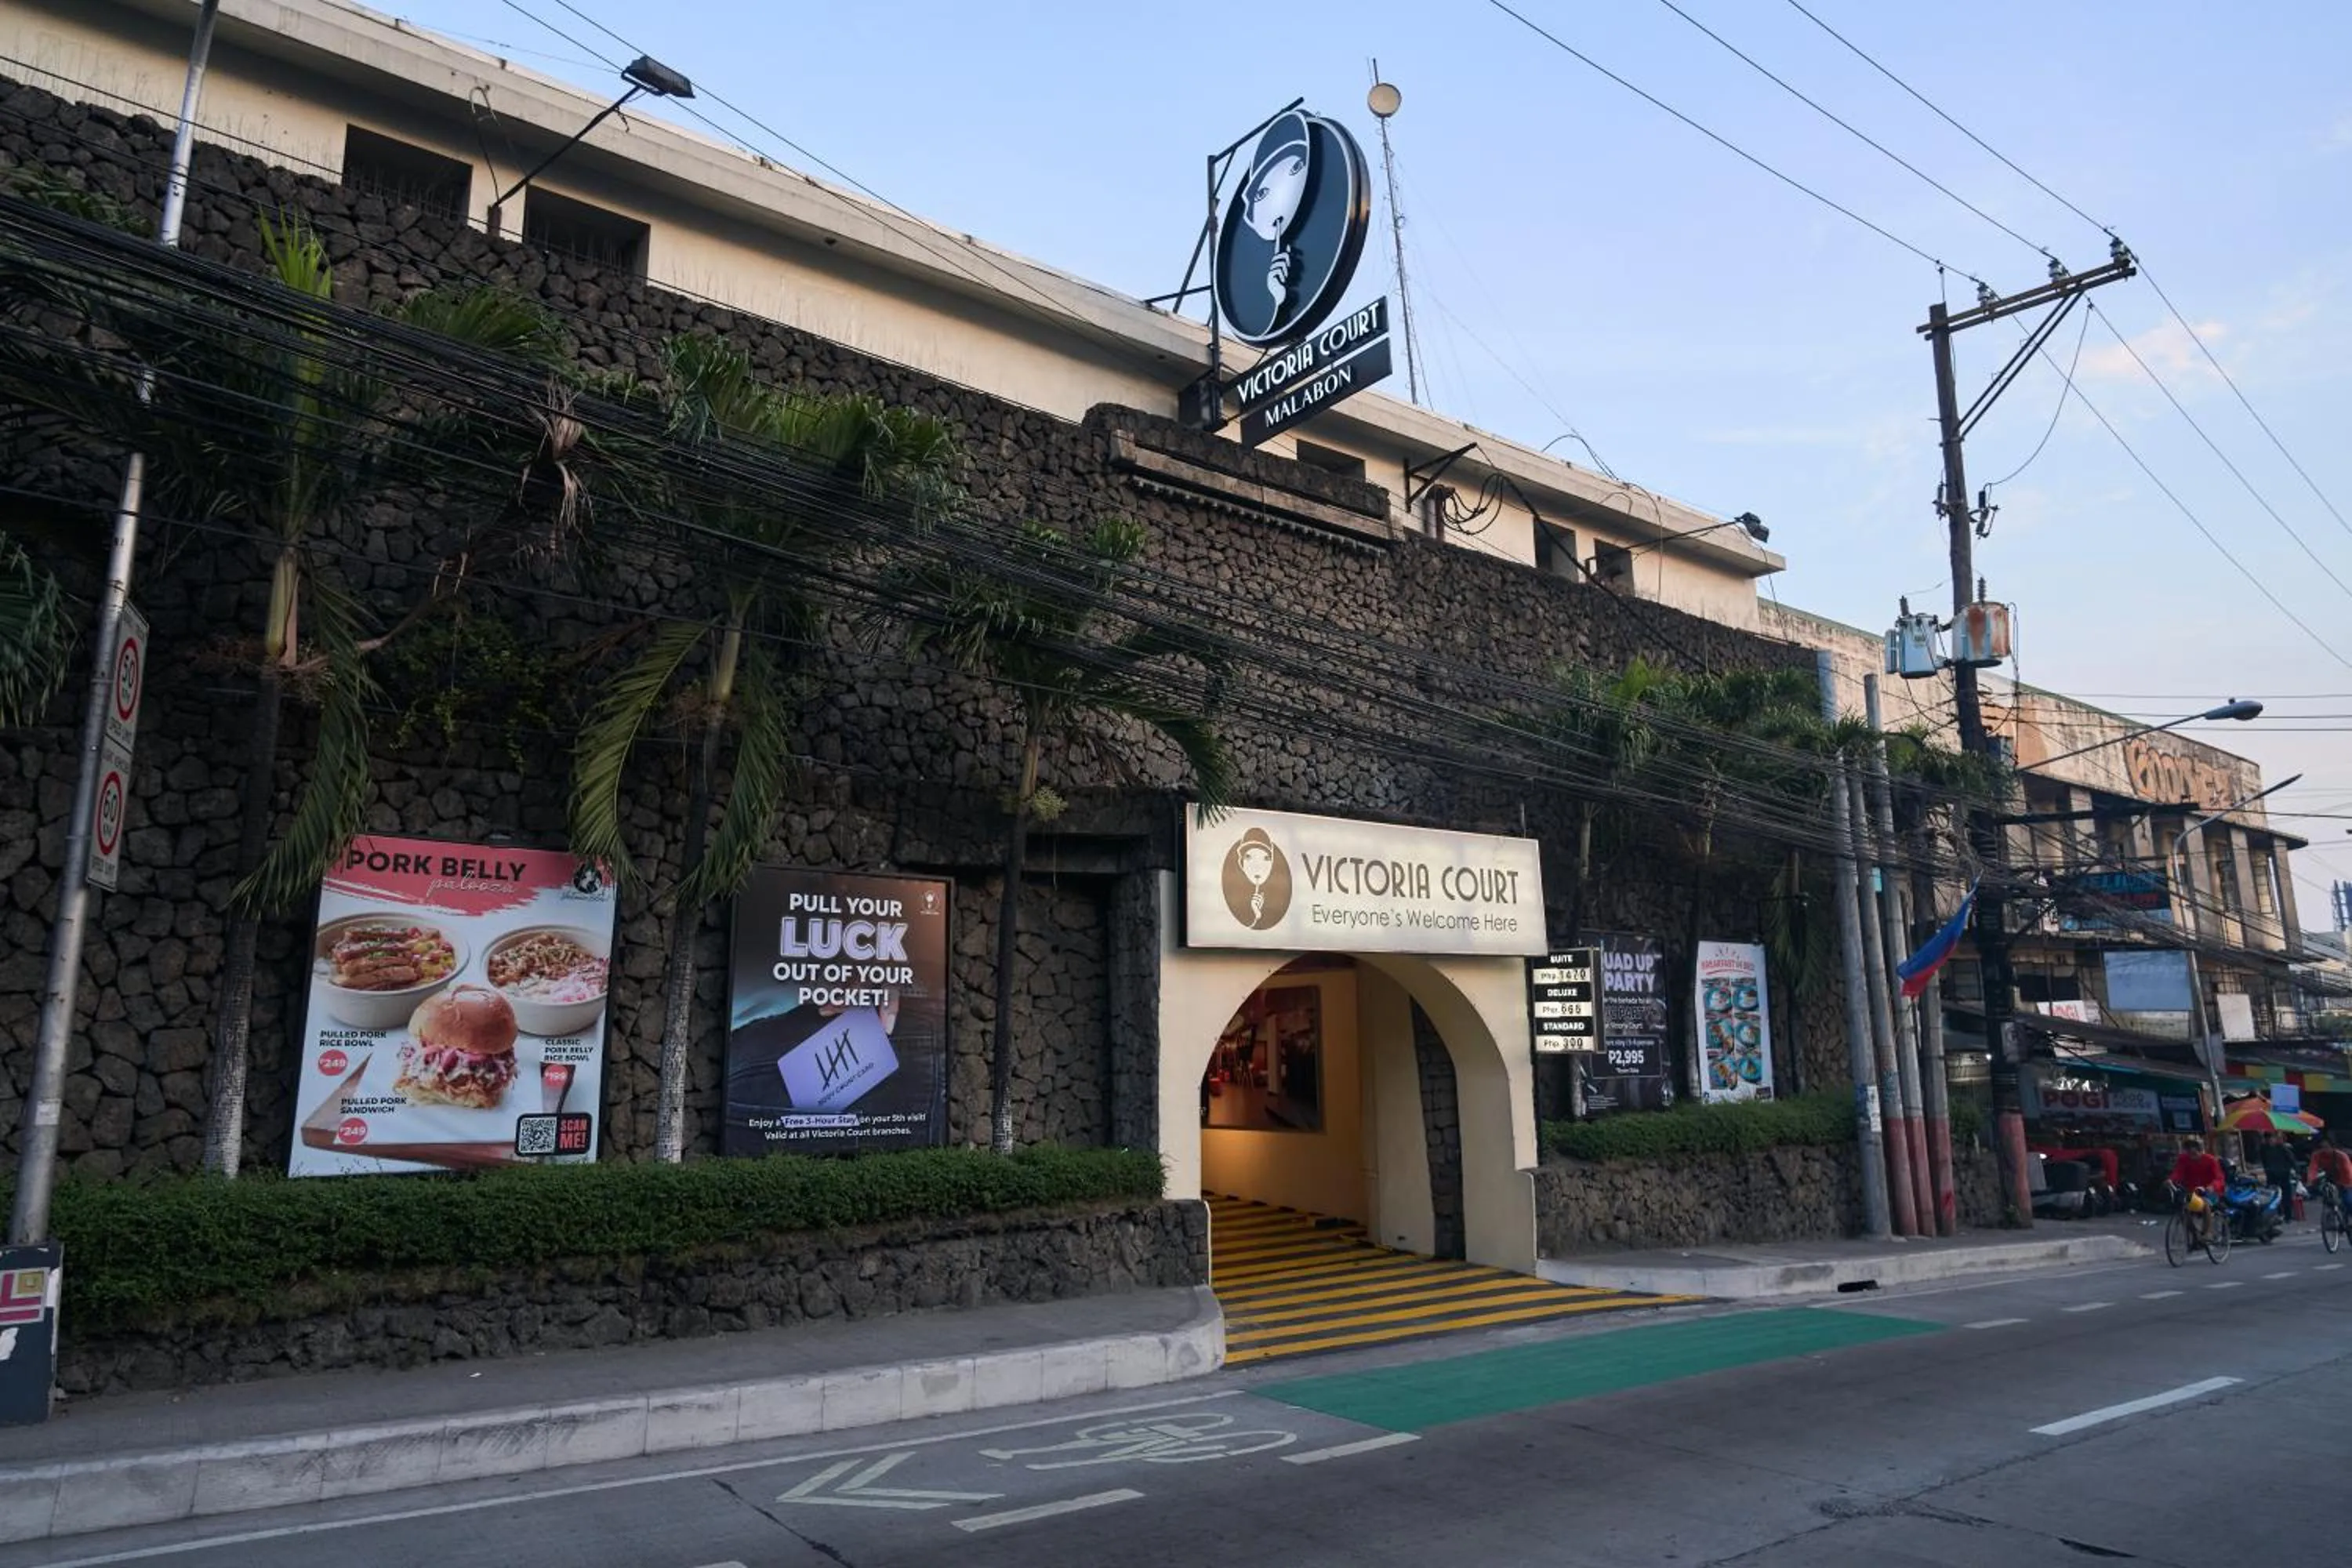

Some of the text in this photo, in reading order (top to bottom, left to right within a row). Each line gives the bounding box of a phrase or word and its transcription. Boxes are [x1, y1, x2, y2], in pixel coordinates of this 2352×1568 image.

[1237, 303, 1379, 404] VICTORIA COURT
[1265, 365, 1352, 427] MALABON
[346, 849, 527, 881] PORK BELLY
[1301, 853, 1519, 905] VICTORIA COURT
[789, 893, 902, 917] PULL YOUR
[1312, 904, 1517, 932] Everyone's Welcome Here
[780, 916, 908, 961] LUCK
[1550, 954, 1573, 964] SUITE
[1603, 952, 1654, 971] UAD UP
[773, 963, 913, 984] OUT OF YOUR
[1603, 971, 1655, 993] PARTY
[799, 987, 888, 1006] POCKET!
[1543, 1022, 1584, 1031] STANDARD
[2042, 1091, 2109, 1109] POGI
[561, 1119, 587, 1131] SCAN
[749, 1118, 773, 1128] Enjoy
[872, 1116, 891, 1124] your
[560, 1132, 586, 1149] ME!
[764, 1131, 787, 1140] Valid
[812, 1129, 845, 1138] Victoria
[847, 1128, 870, 1137] Court
